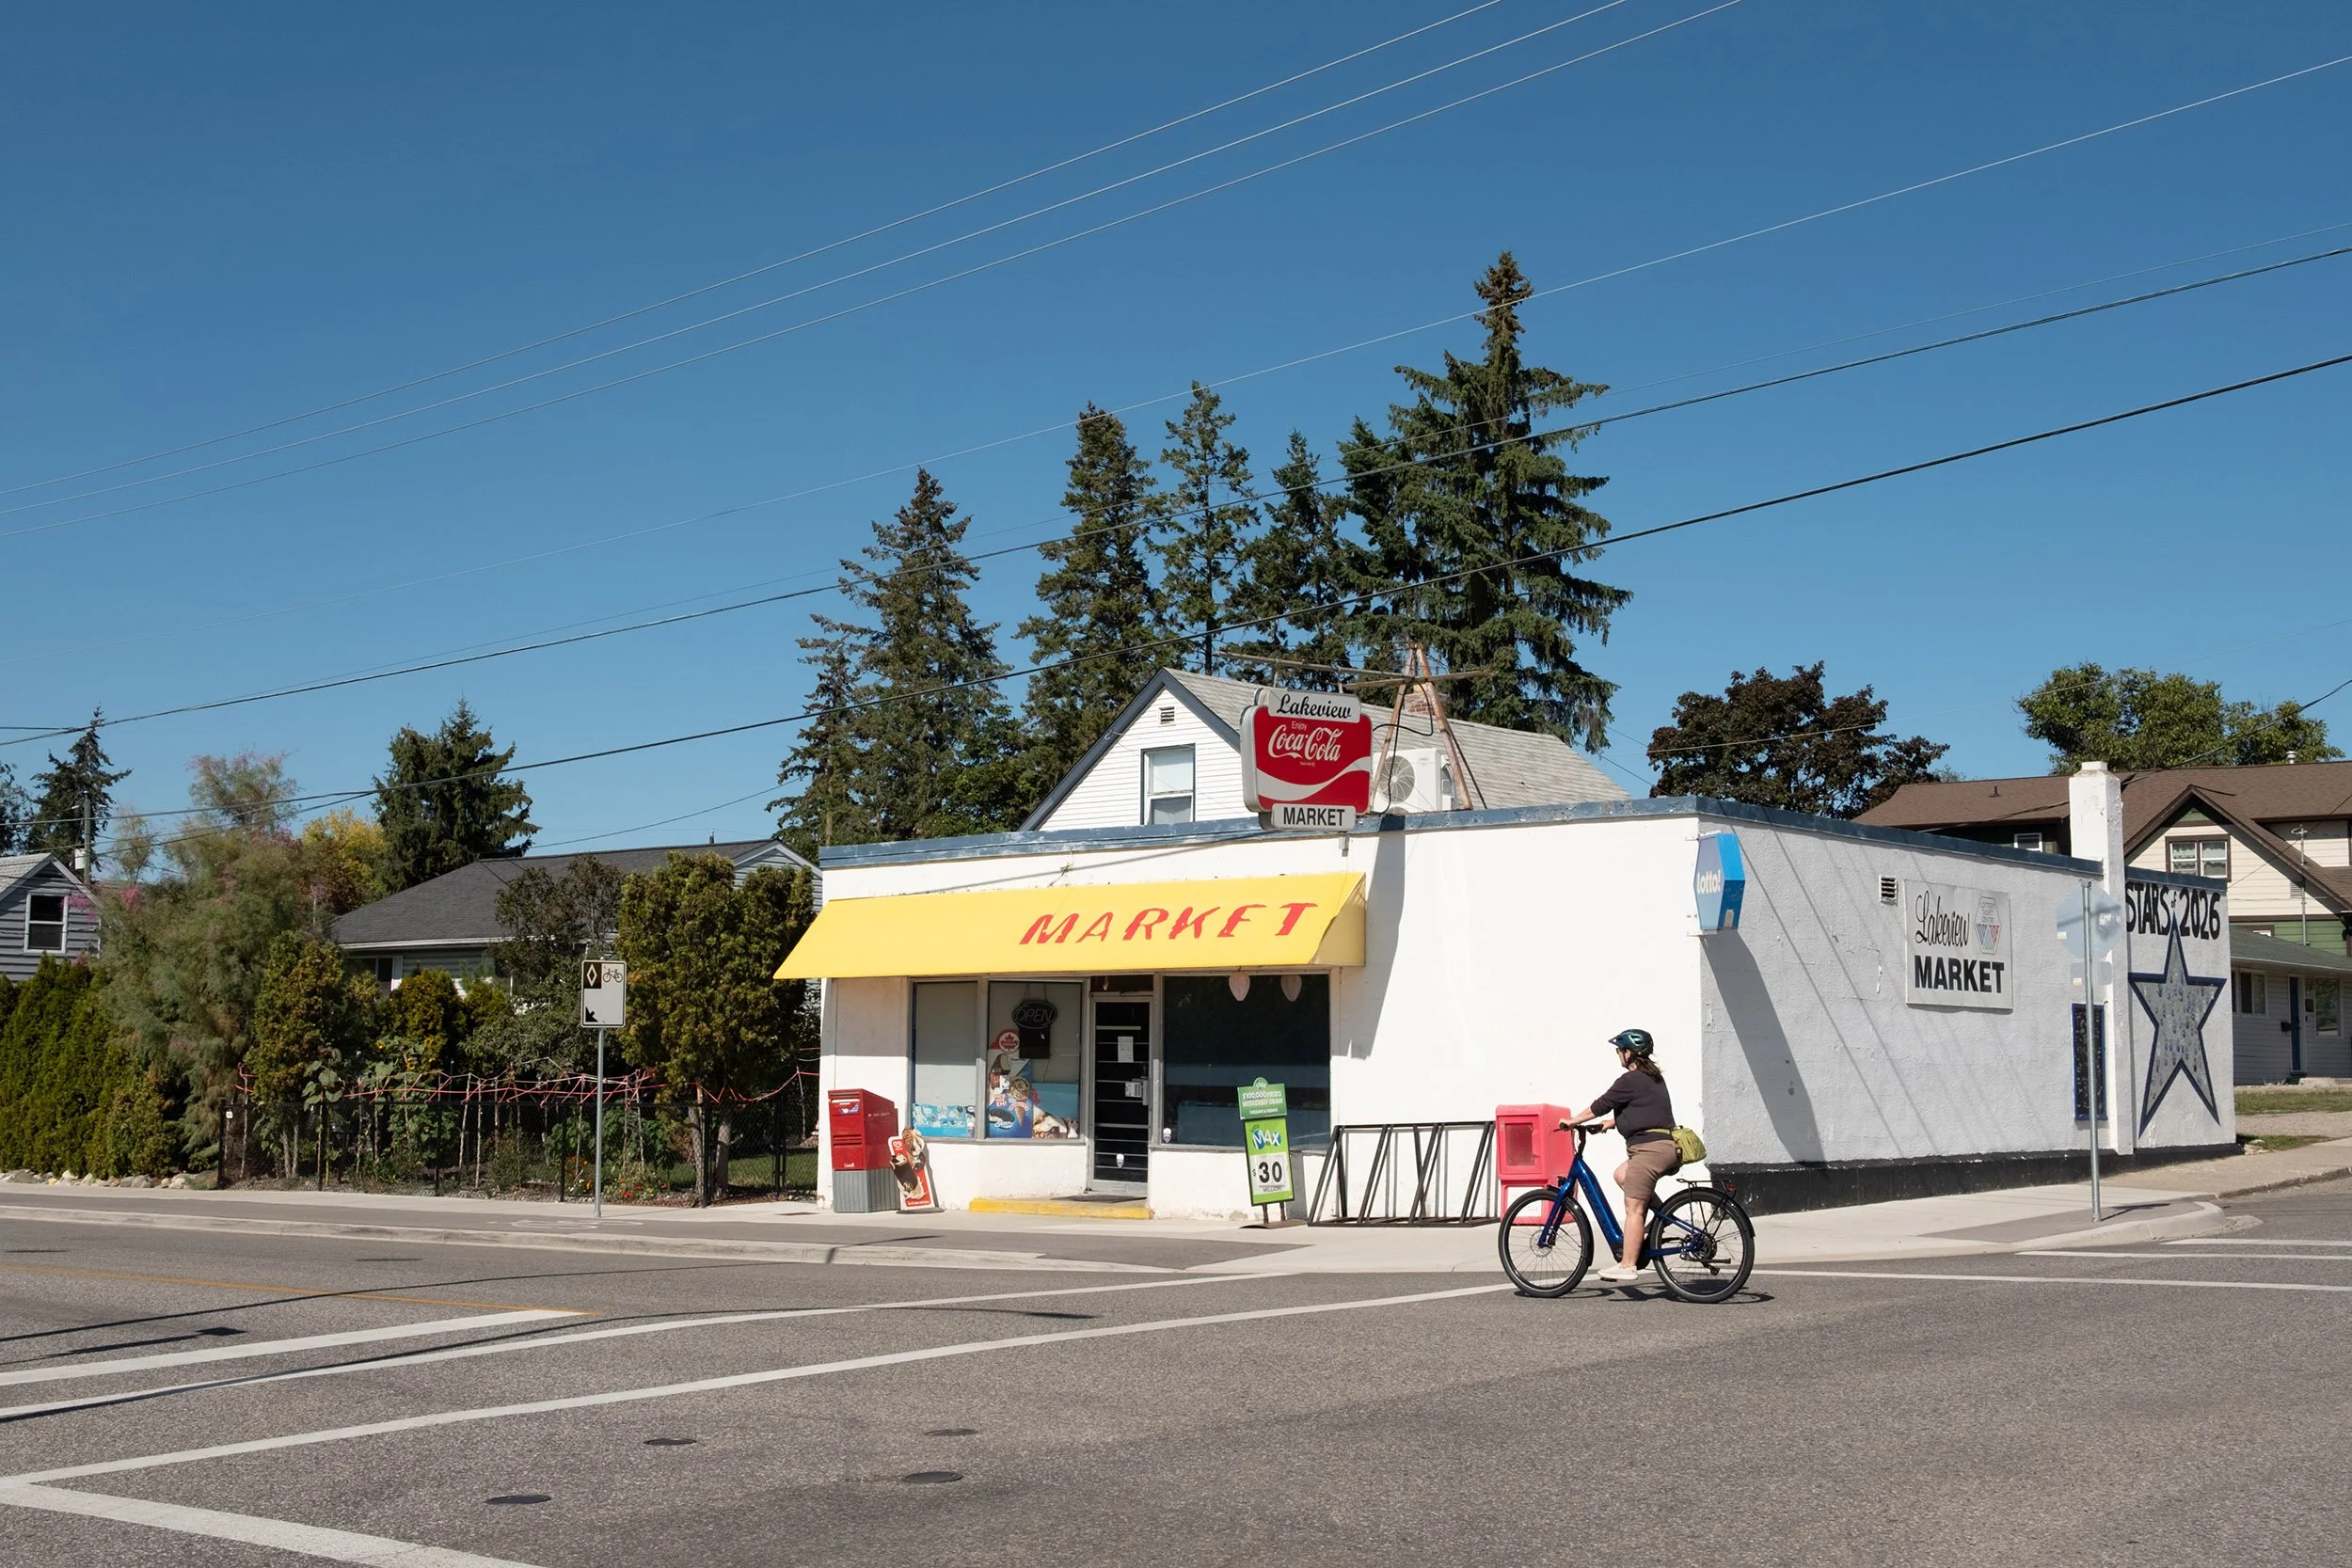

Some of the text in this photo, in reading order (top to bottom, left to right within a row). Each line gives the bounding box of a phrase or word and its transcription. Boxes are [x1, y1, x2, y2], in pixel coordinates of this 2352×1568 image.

[1277, 693, 1351, 719] Lakeview
[1292, 721, 1307, 731] Enjoy
[1268, 724, 1343, 761] Coca-Cola
[1283, 807, 1345, 827] MARKET
[1697, 869, 1721, 895] lotto!
[1019, 902, 1319, 945] MARKET
[1915, 890, 1970, 948] Lakeview
[2125, 880, 2171, 936] STARS
[2179, 887, 2221, 941] 2026
[1915, 955, 2005, 994] MARKET
[1016, 1008, 1053, 1022] OPEN
[1252, 1129, 1280, 1150] MAX
[1252, 1161, 1282, 1183] $ 30
